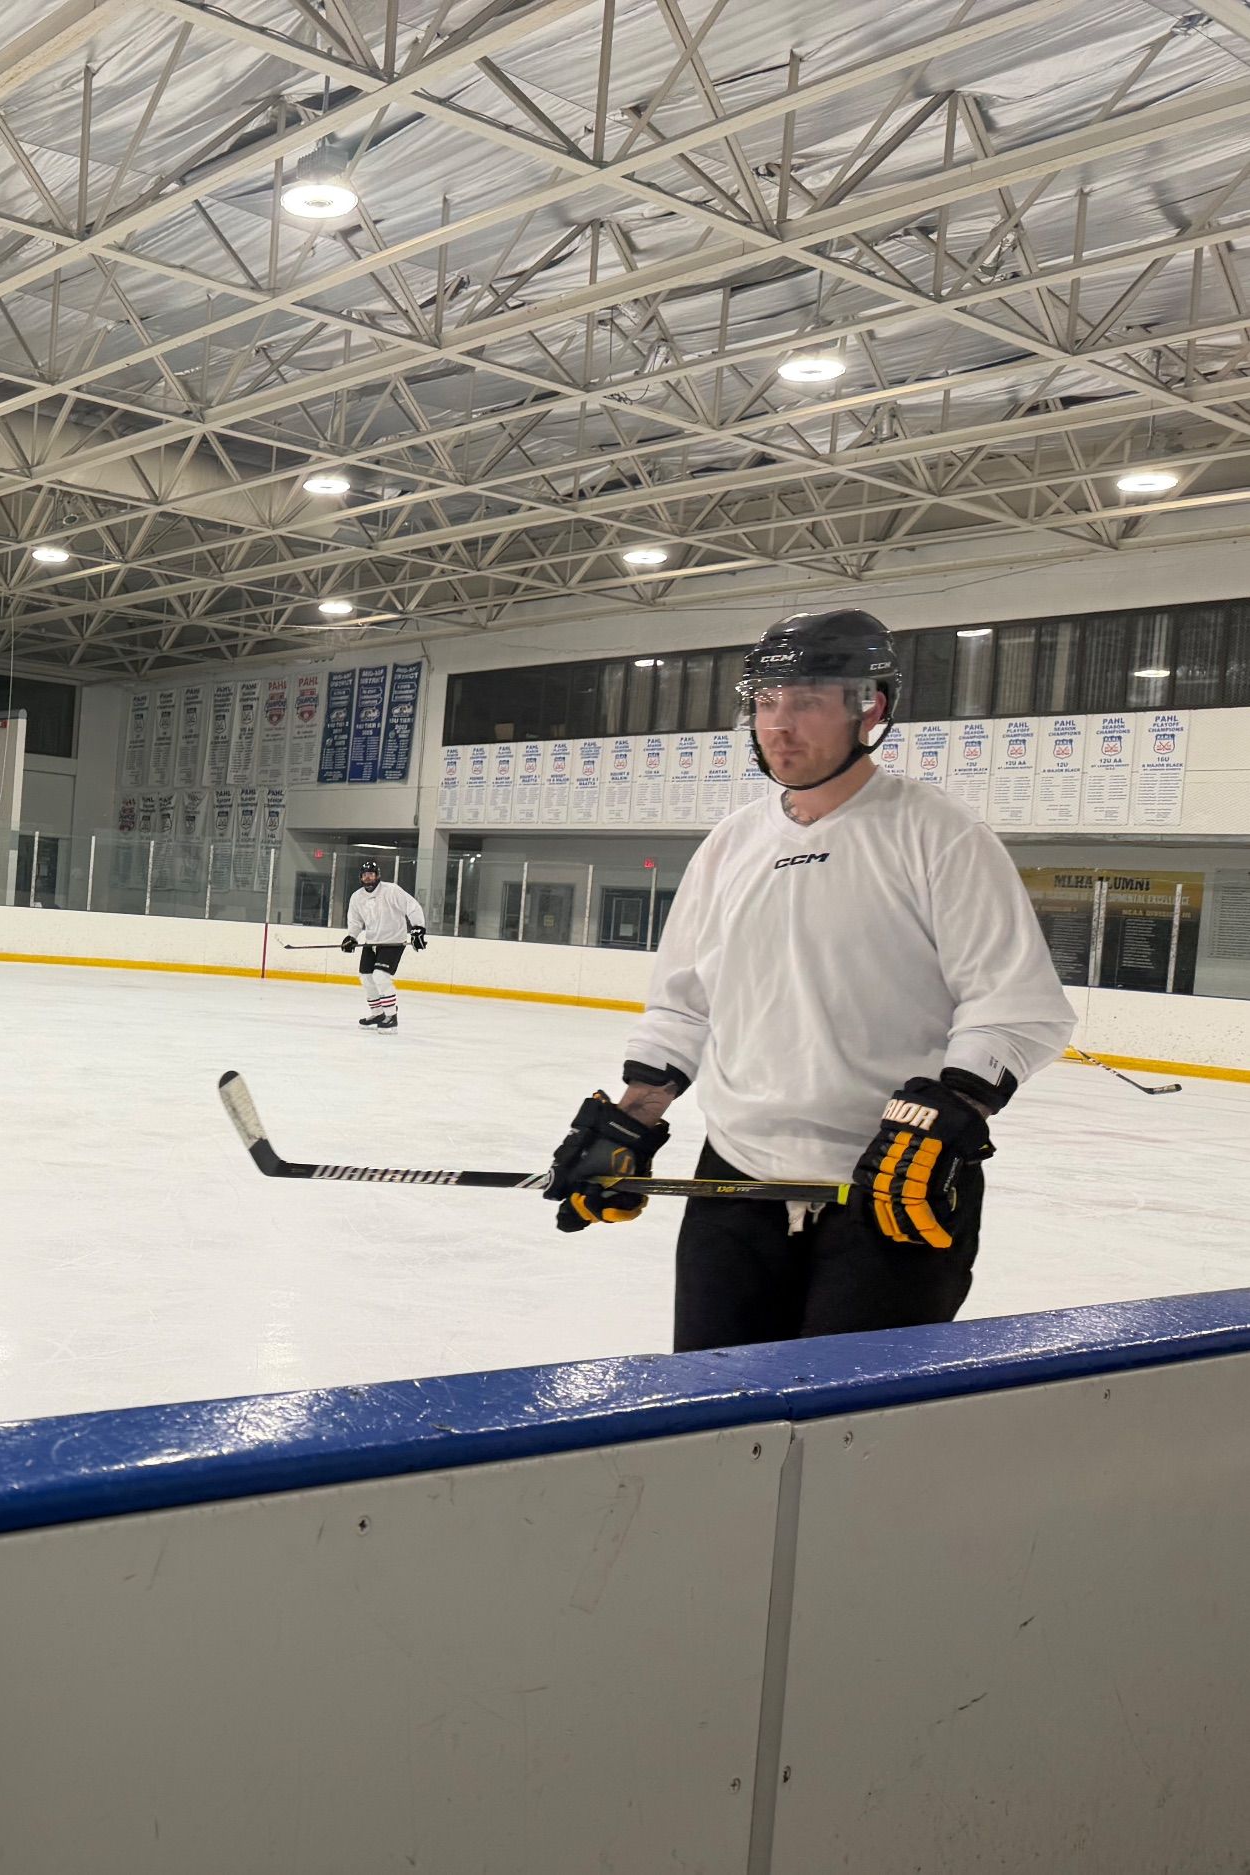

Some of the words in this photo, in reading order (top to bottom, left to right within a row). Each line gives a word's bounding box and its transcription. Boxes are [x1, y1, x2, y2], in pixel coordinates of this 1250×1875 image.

[760, 653, 796, 663] CCM
[870, 661, 891, 671] CCM
[268, 680, 287, 690] PAHL
[298, 676, 318, 687] PAHL
[1102, 717, 1125, 725] PAHL
[1154, 715, 1179, 723] PAHL
[774, 852, 830, 870] CCM
[310, 1165, 461, 1185] WARRIOR
